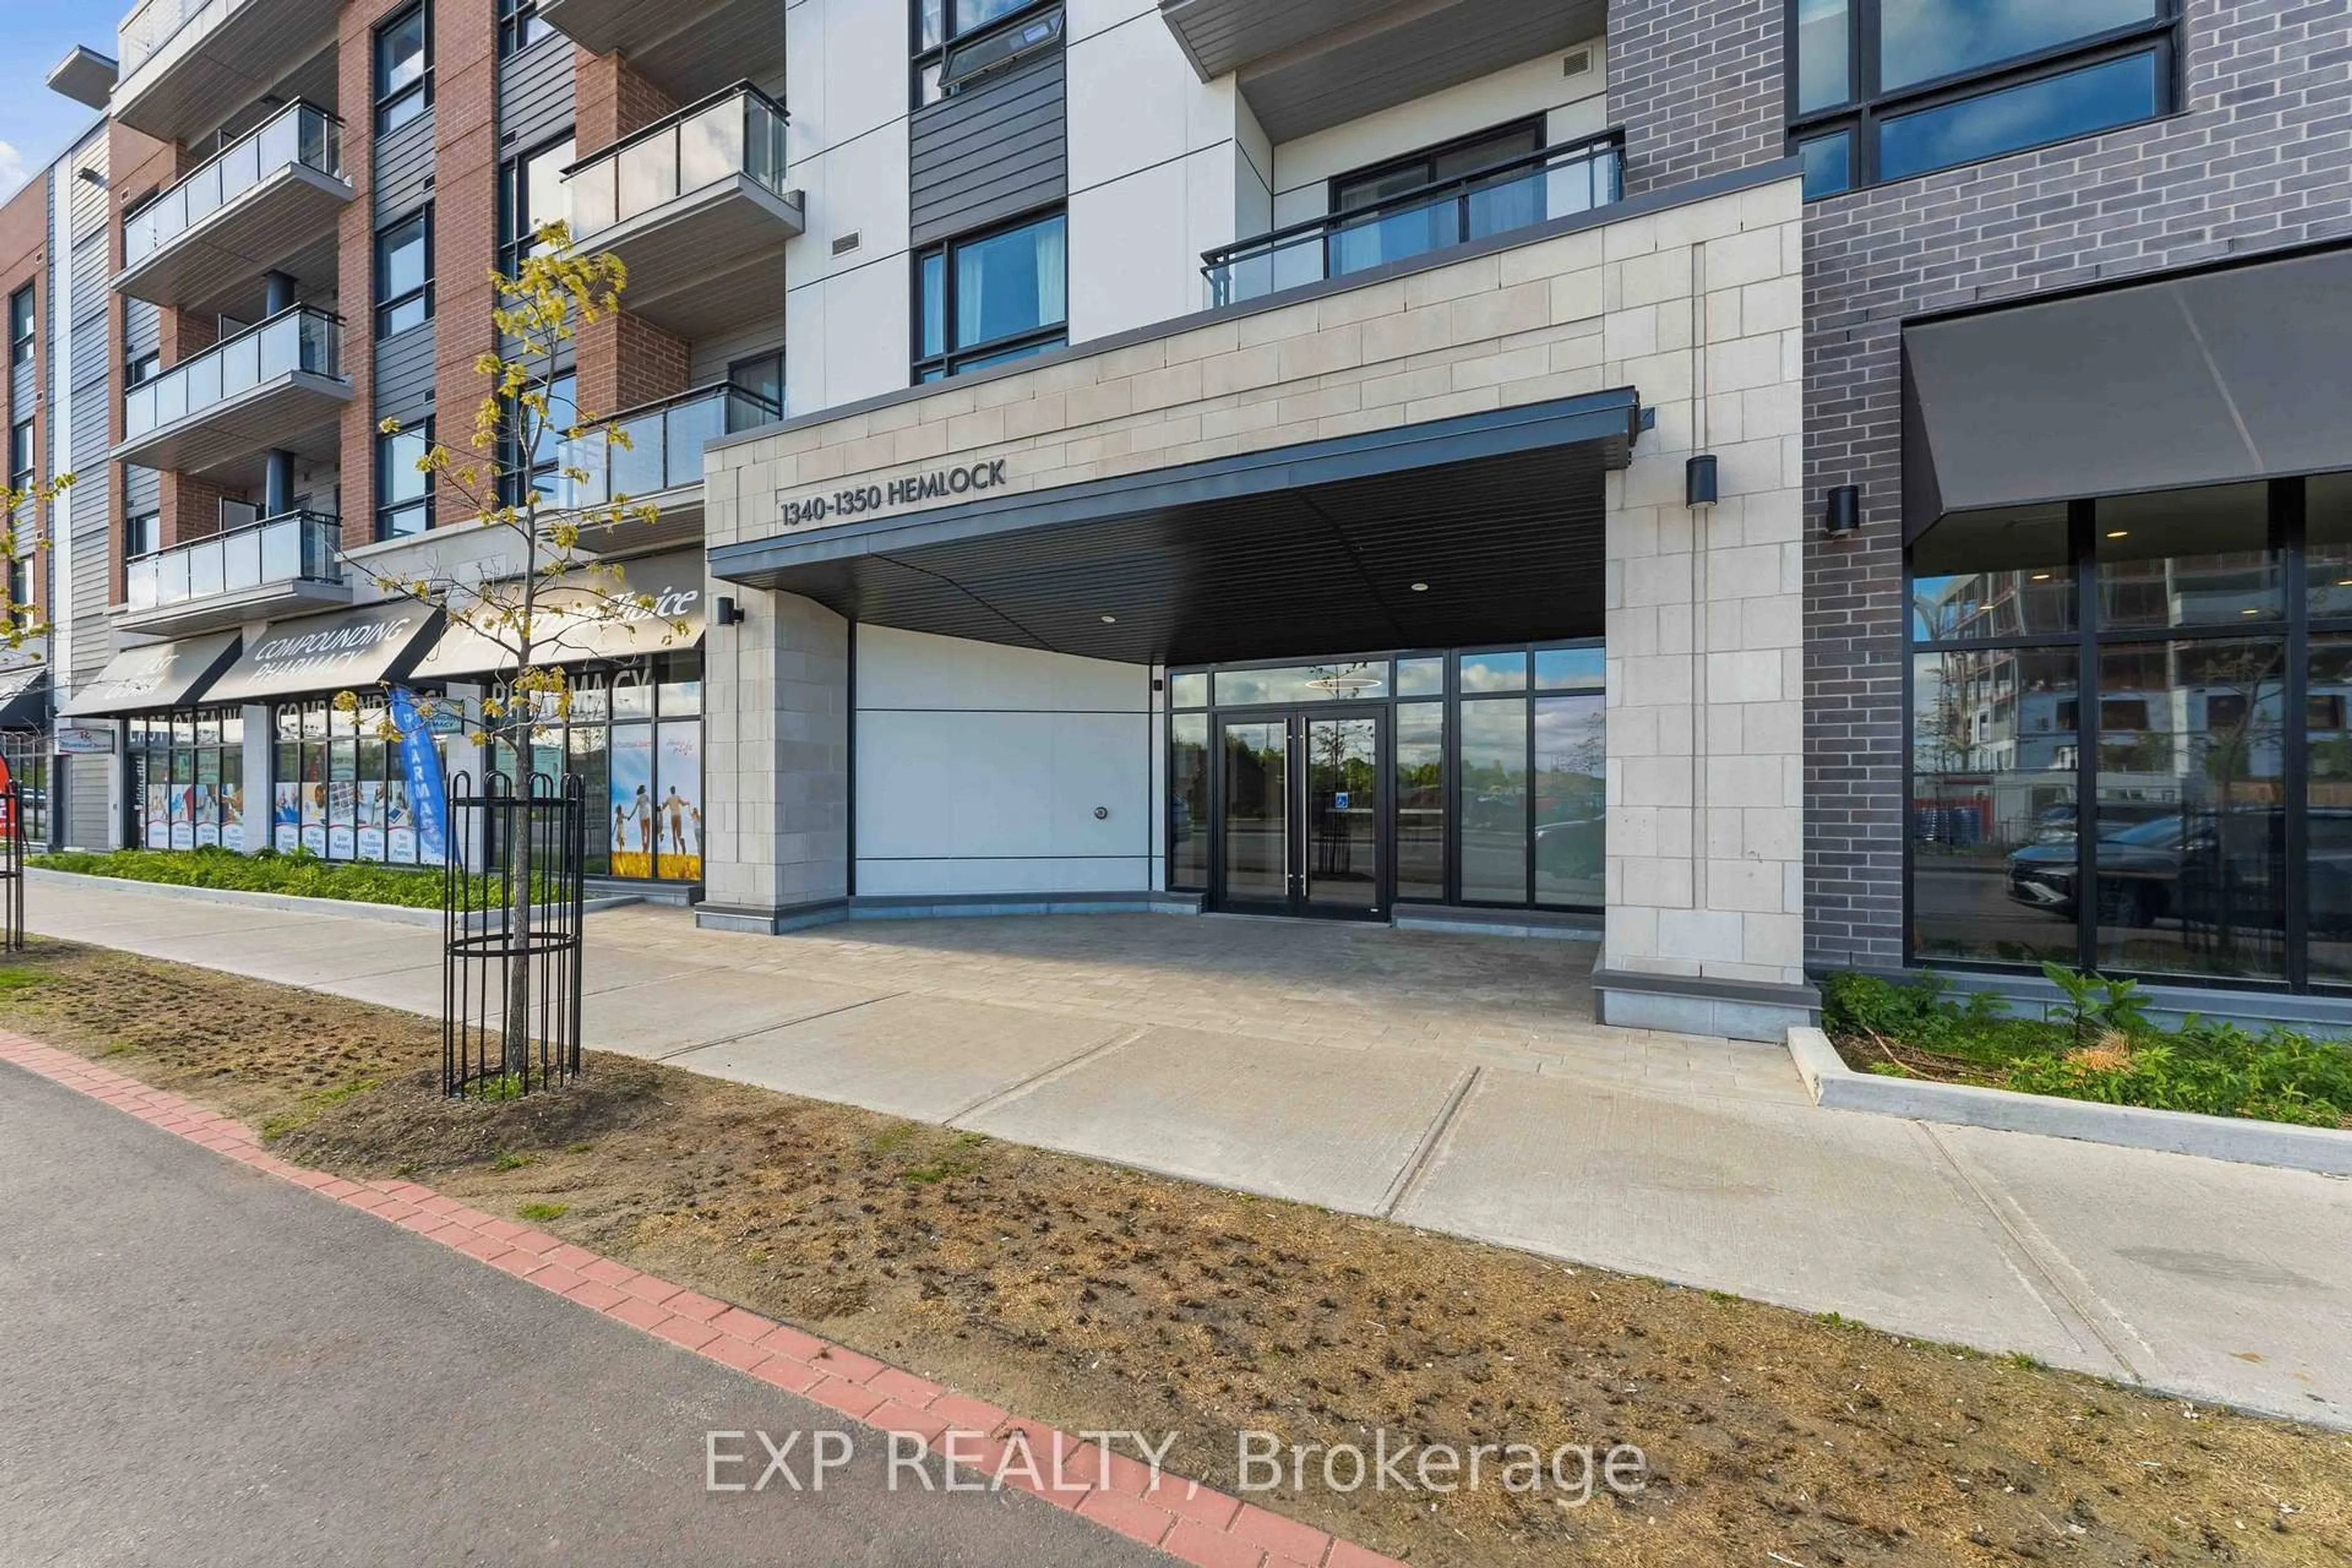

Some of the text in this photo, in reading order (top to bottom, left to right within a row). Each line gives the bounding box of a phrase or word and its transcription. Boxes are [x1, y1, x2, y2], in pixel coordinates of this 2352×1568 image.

[781, 459, 1006, 526] 1340-1350 HEMLOCK
[255, 617, 411, 661] COMPOUNDING
[246, 649, 366, 685] PHARMACY
[491, 668, 651, 718] PMACY
